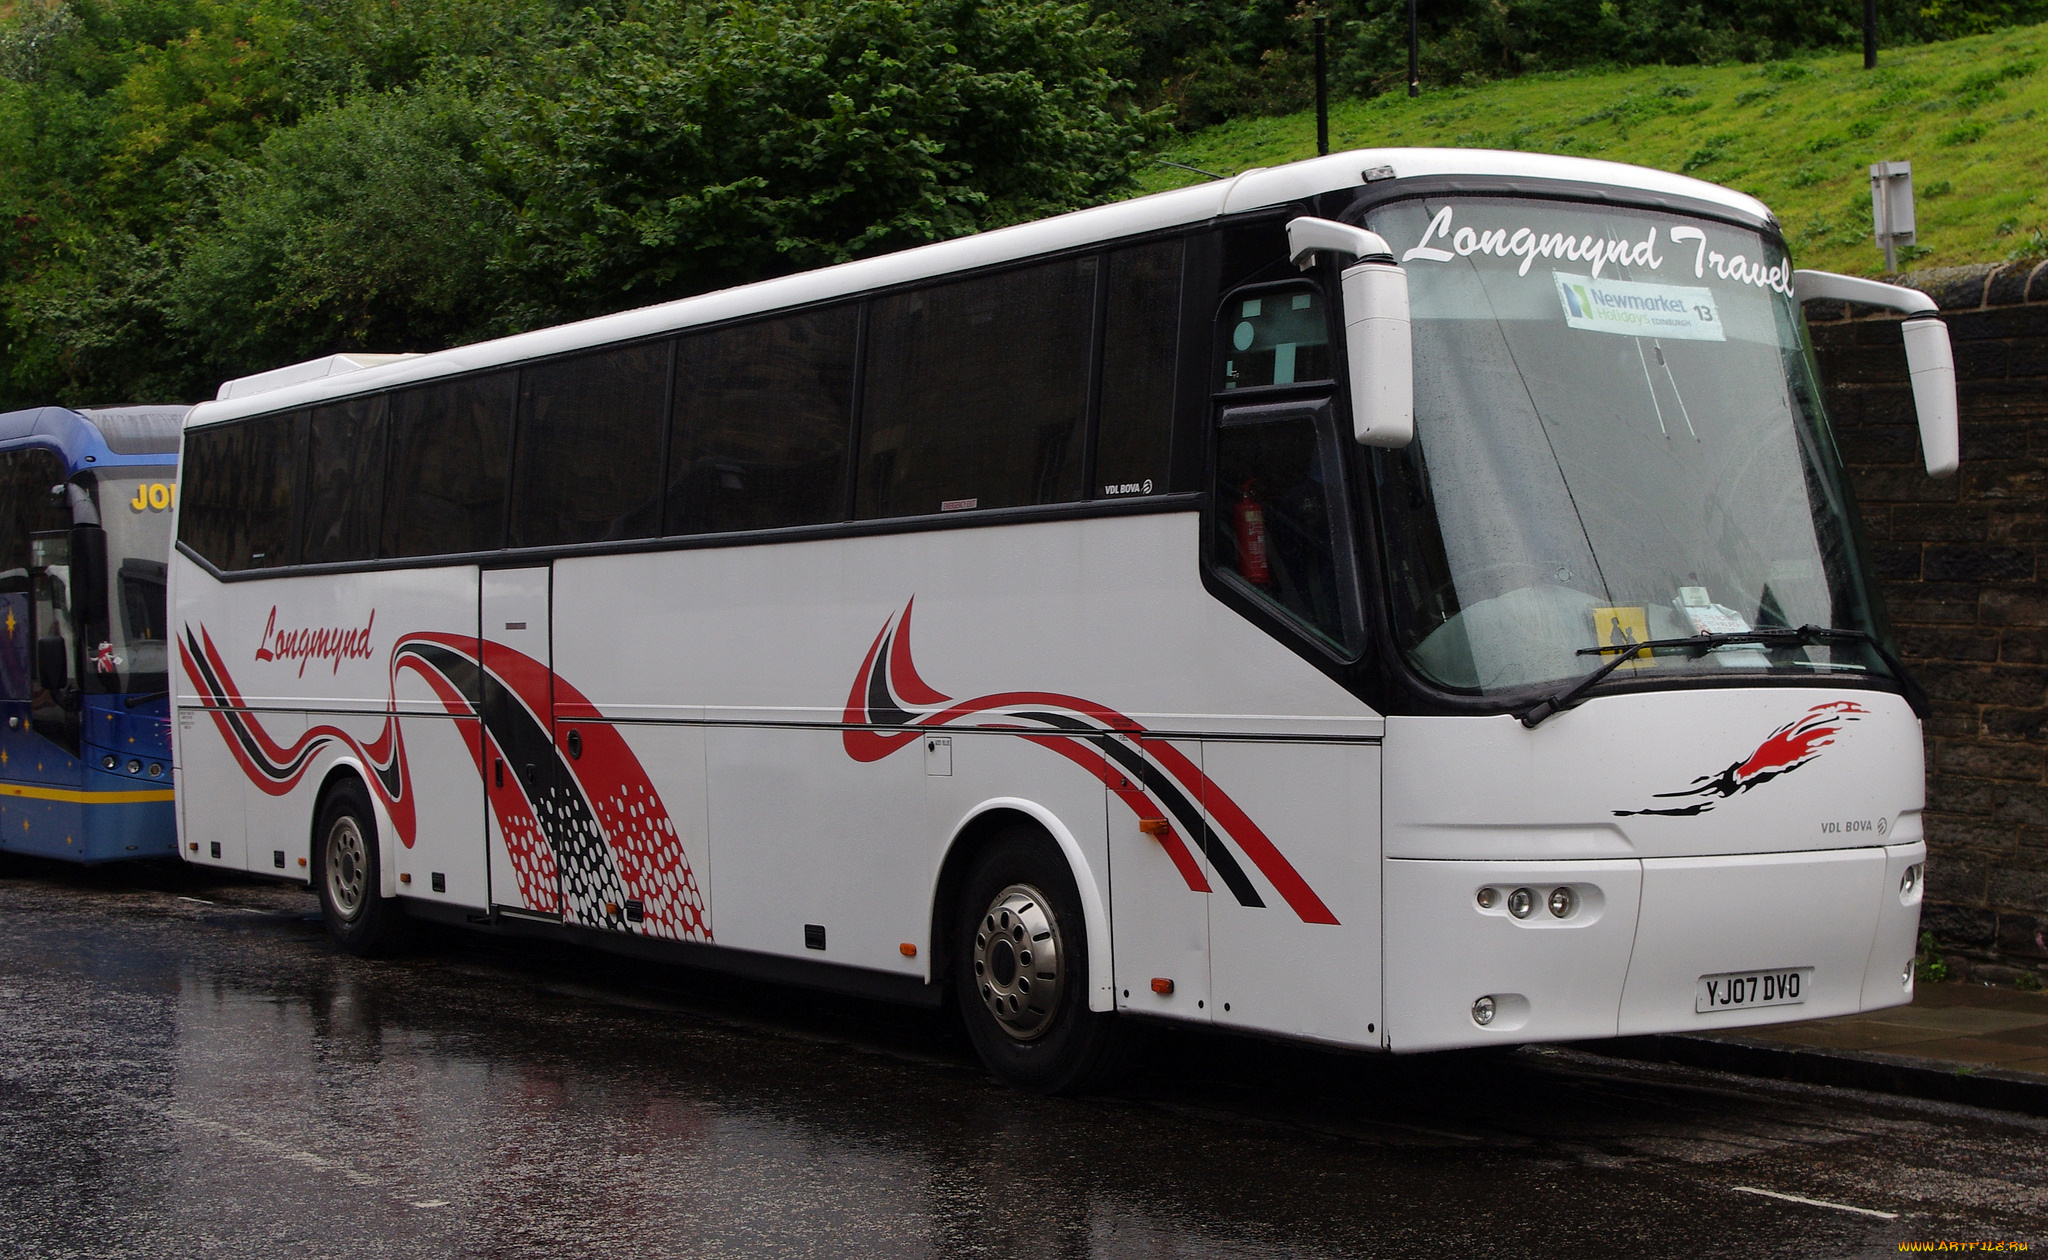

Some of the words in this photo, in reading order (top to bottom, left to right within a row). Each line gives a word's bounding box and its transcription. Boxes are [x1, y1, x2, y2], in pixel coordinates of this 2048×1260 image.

[1402, 205, 1663, 279] Longmynd
[1670, 225, 1795, 298] Travel
[1591, 288, 1688, 313] Newmarket
[1597, 308, 1650, 326] Holidays
[1651, 318, 1692, 327] EDINBURGH
[1693, 305, 1713, 322] 13
[1105, 485, 1119, 494] VDL
[1120, 483, 1140, 493] BOVA
[255, 605, 375, 679] Longmynd
[1821, 822, 1841, 833] VDL
[1846, 820, 1872, 832] BOVA
[1707, 977, 1758, 1006] YJ07
[1763, 973, 1800, 1000] DVO
